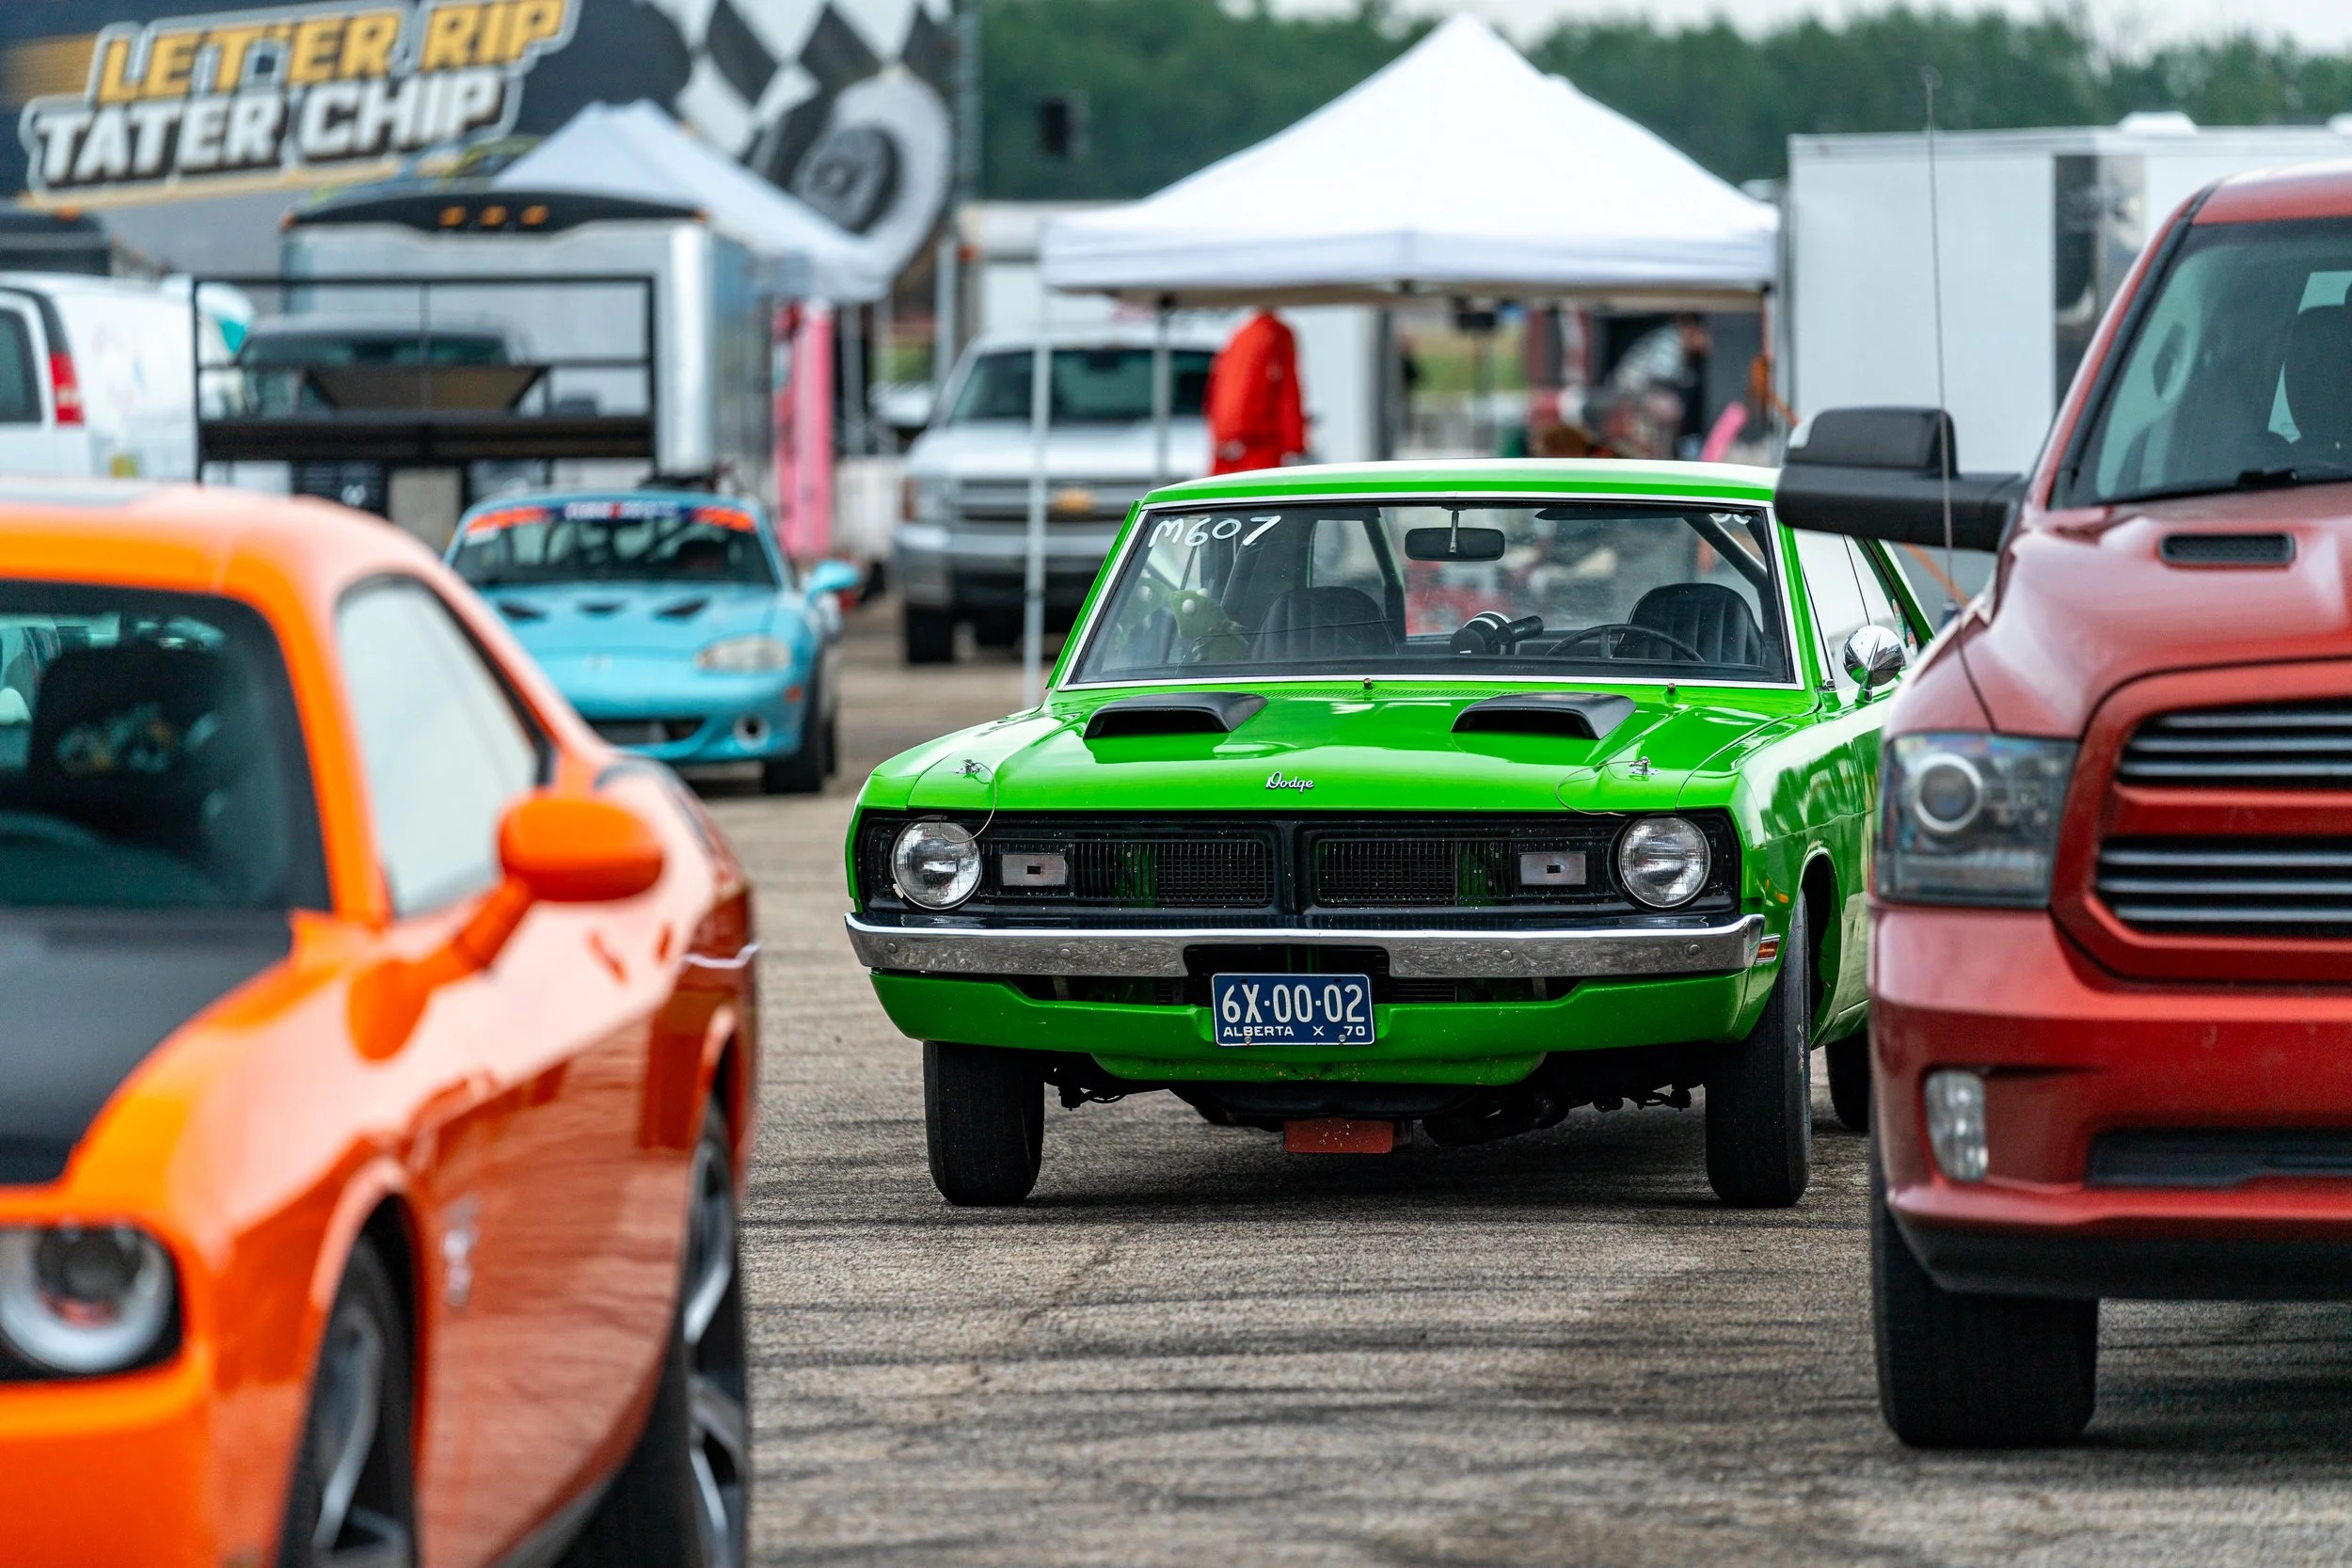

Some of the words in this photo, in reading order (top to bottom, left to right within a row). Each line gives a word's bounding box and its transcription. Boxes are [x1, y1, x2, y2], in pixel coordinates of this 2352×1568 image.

[421, 0, 565, 70] RIP
[37, 95, 284, 183] TATER
[300, 70, 502, 156] CHIP
[1148, 515, 1281, 548] M607
[1265, 770, 1314, 793] Dodge
[1223, 1025, 1295, 1037] ALBERTA
[1312, 1025, 1325, 1037] X
[1343, 1025, 1366, 1037] 70
